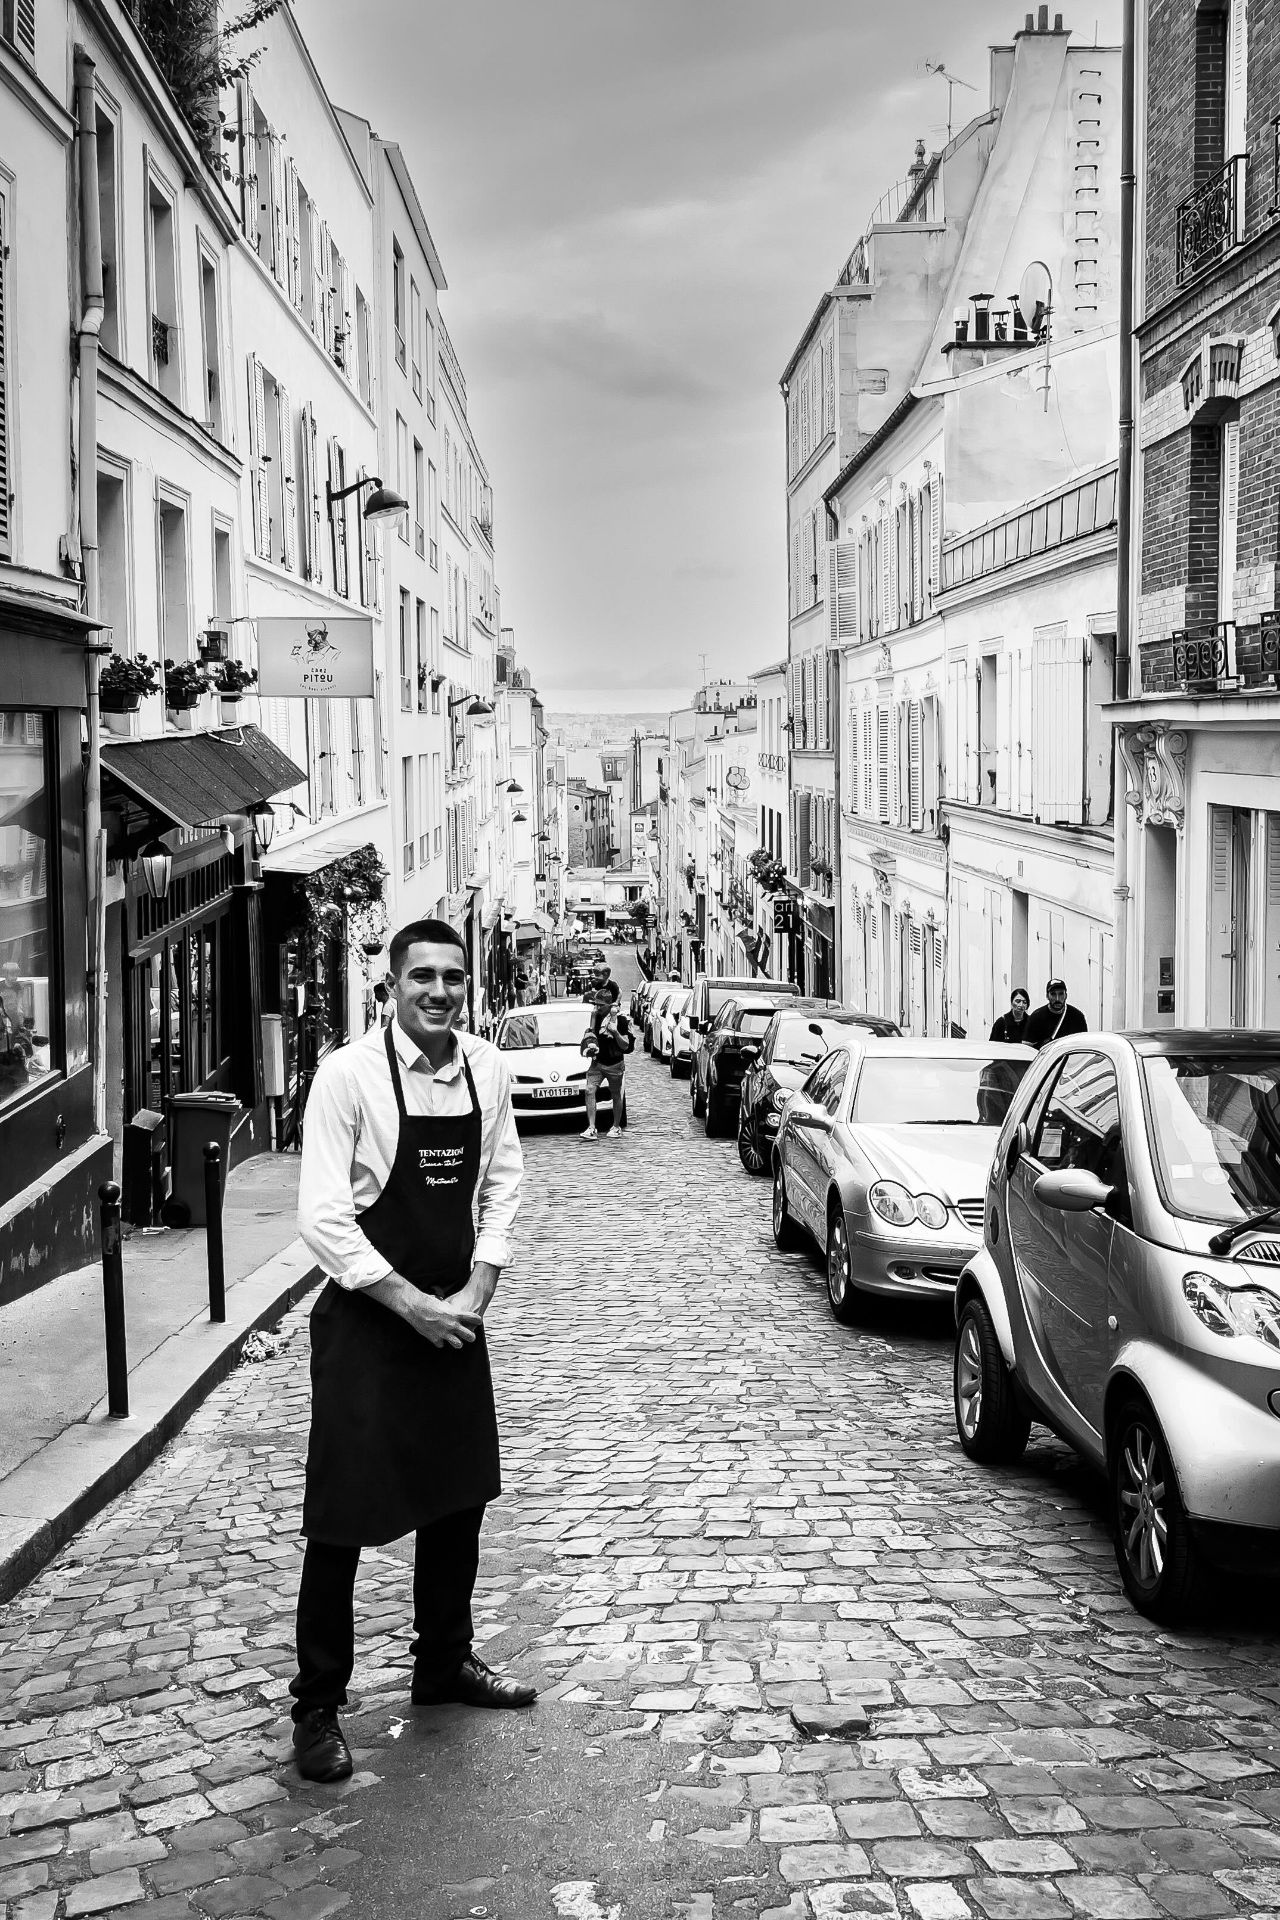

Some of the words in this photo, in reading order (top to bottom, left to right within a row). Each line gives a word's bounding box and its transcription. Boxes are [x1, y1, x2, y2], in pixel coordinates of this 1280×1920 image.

[303, 674, 333, 682] PITOU
[774, 900, 794, 912] art
[774, 914, 793, 929] 21
